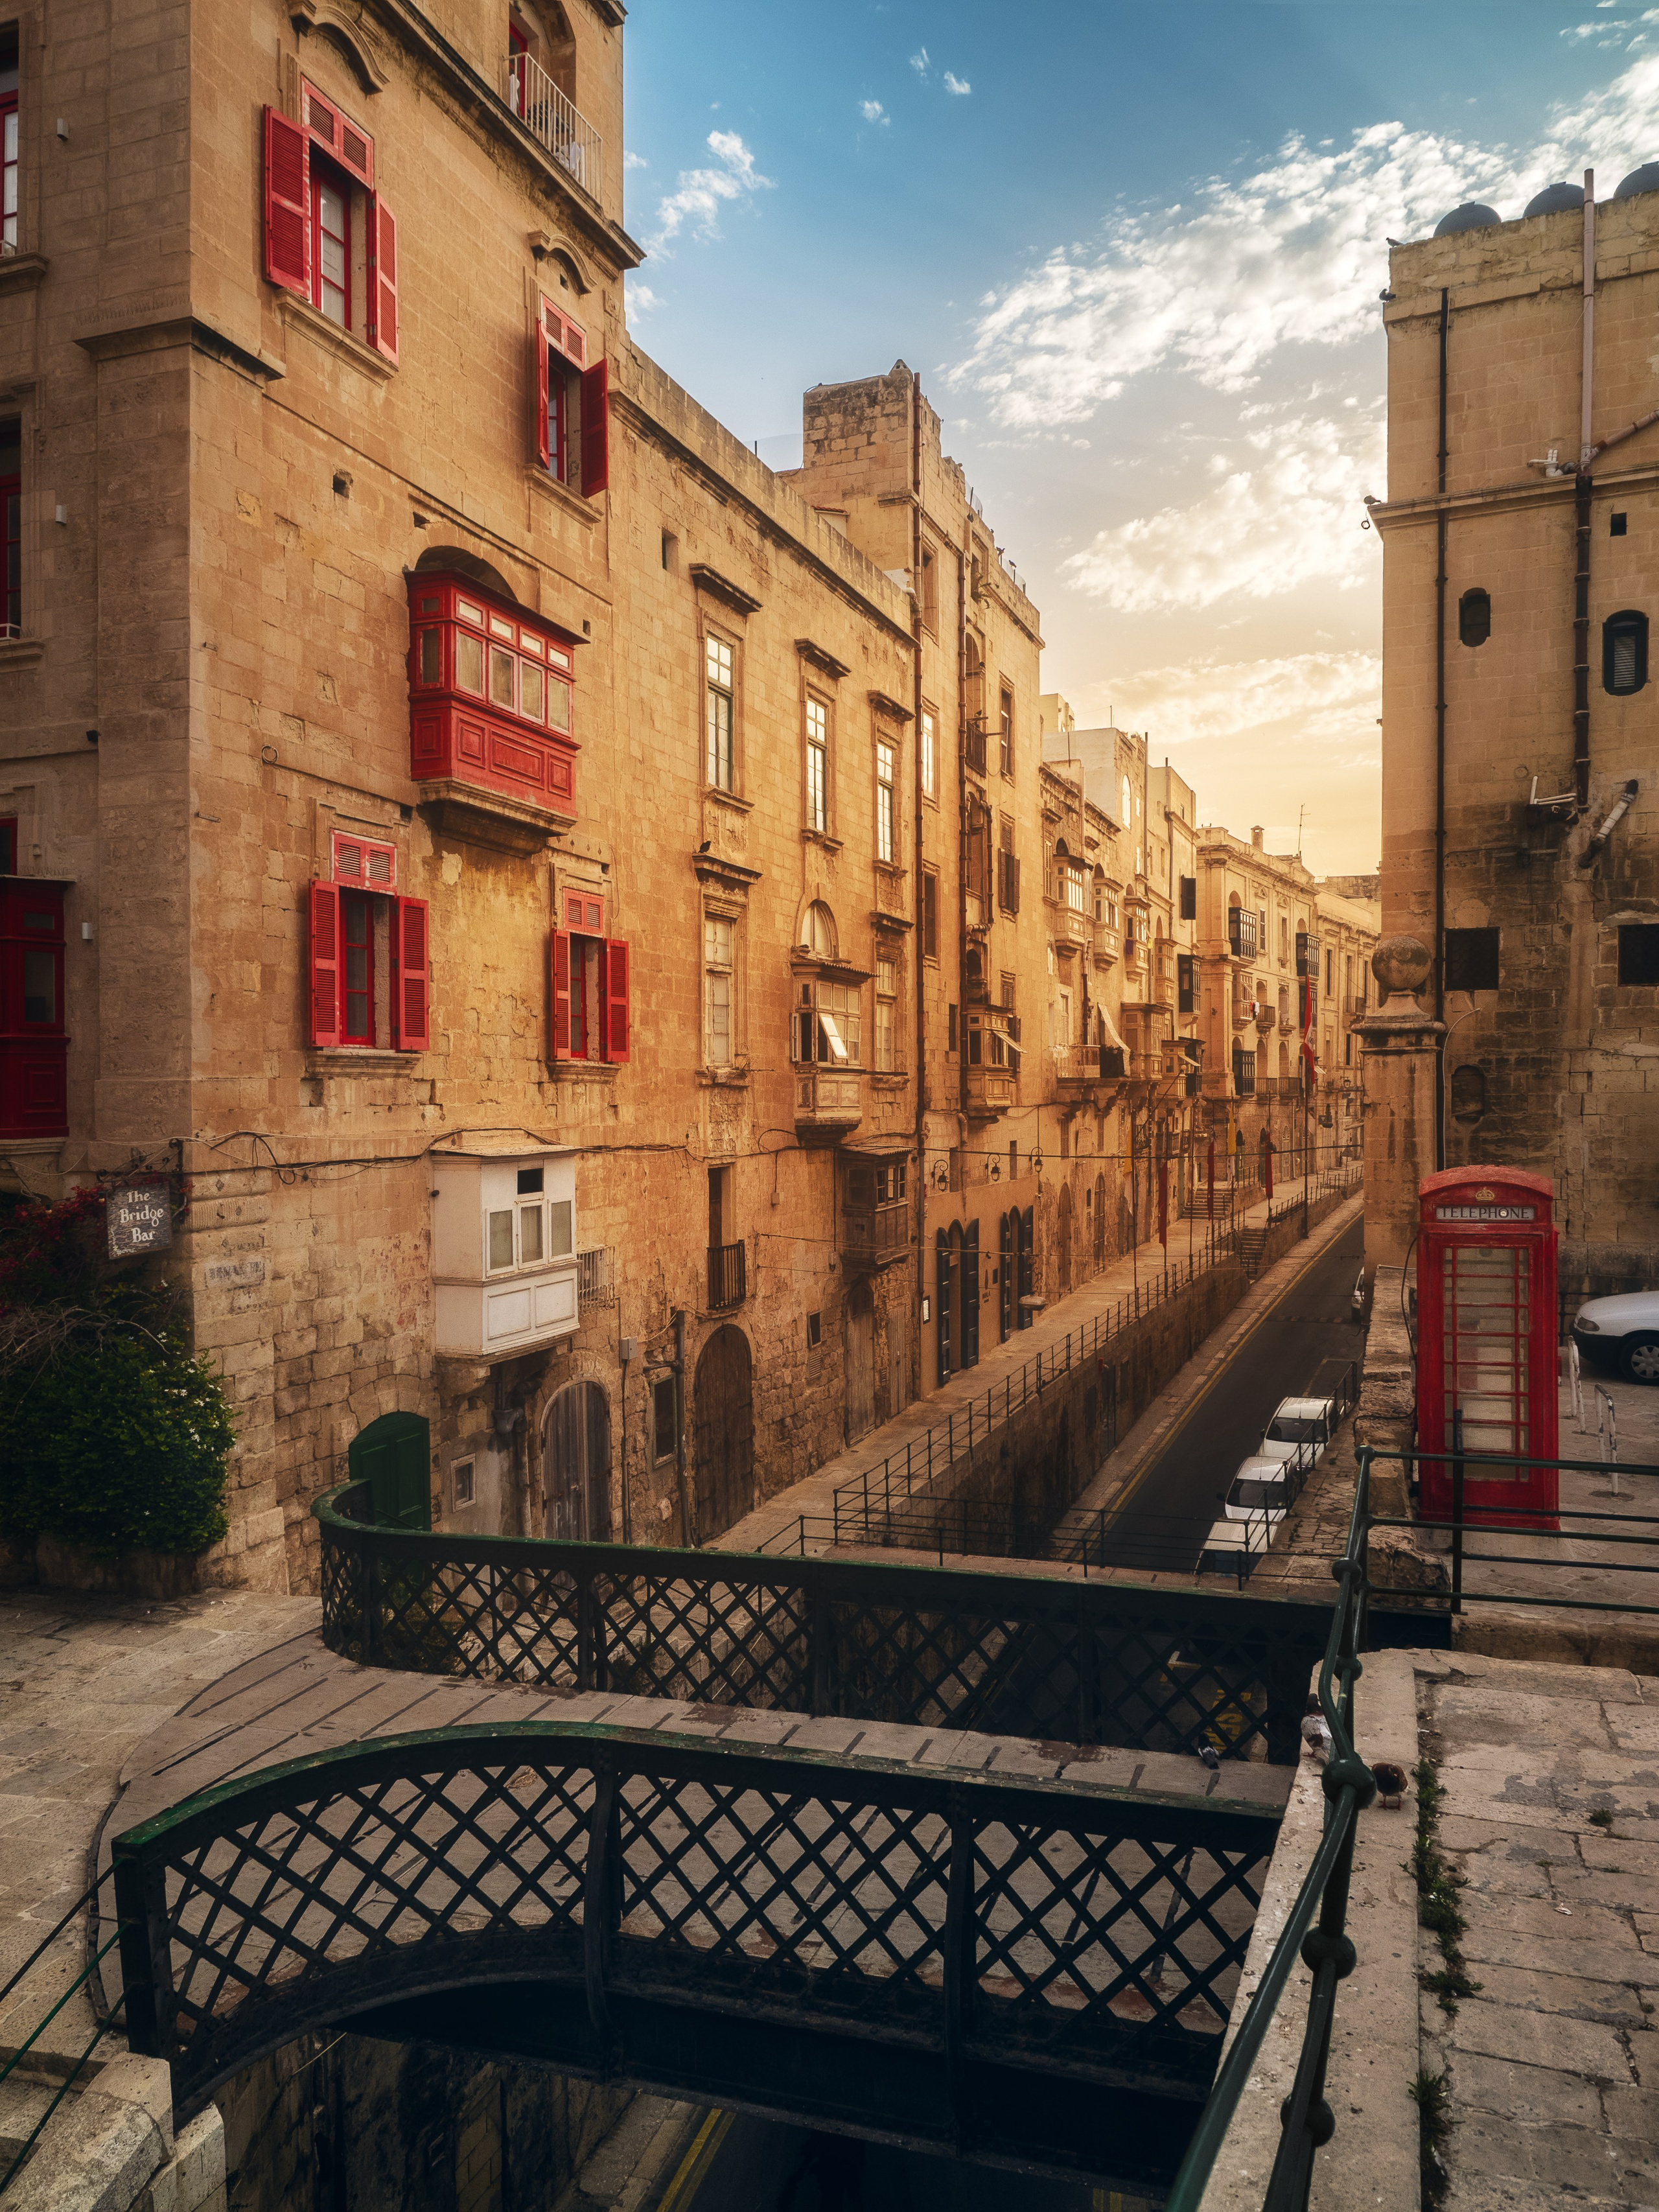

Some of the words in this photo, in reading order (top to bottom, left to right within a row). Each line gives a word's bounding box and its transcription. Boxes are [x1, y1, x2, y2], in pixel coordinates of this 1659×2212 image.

[127, 1191, 151, 1203] The
[120, 1205, 164, 1227] Bridge
[1441, 1207, 1529, 1219] TELEPHONE
[131, 1228, 156, 1242] Bar
